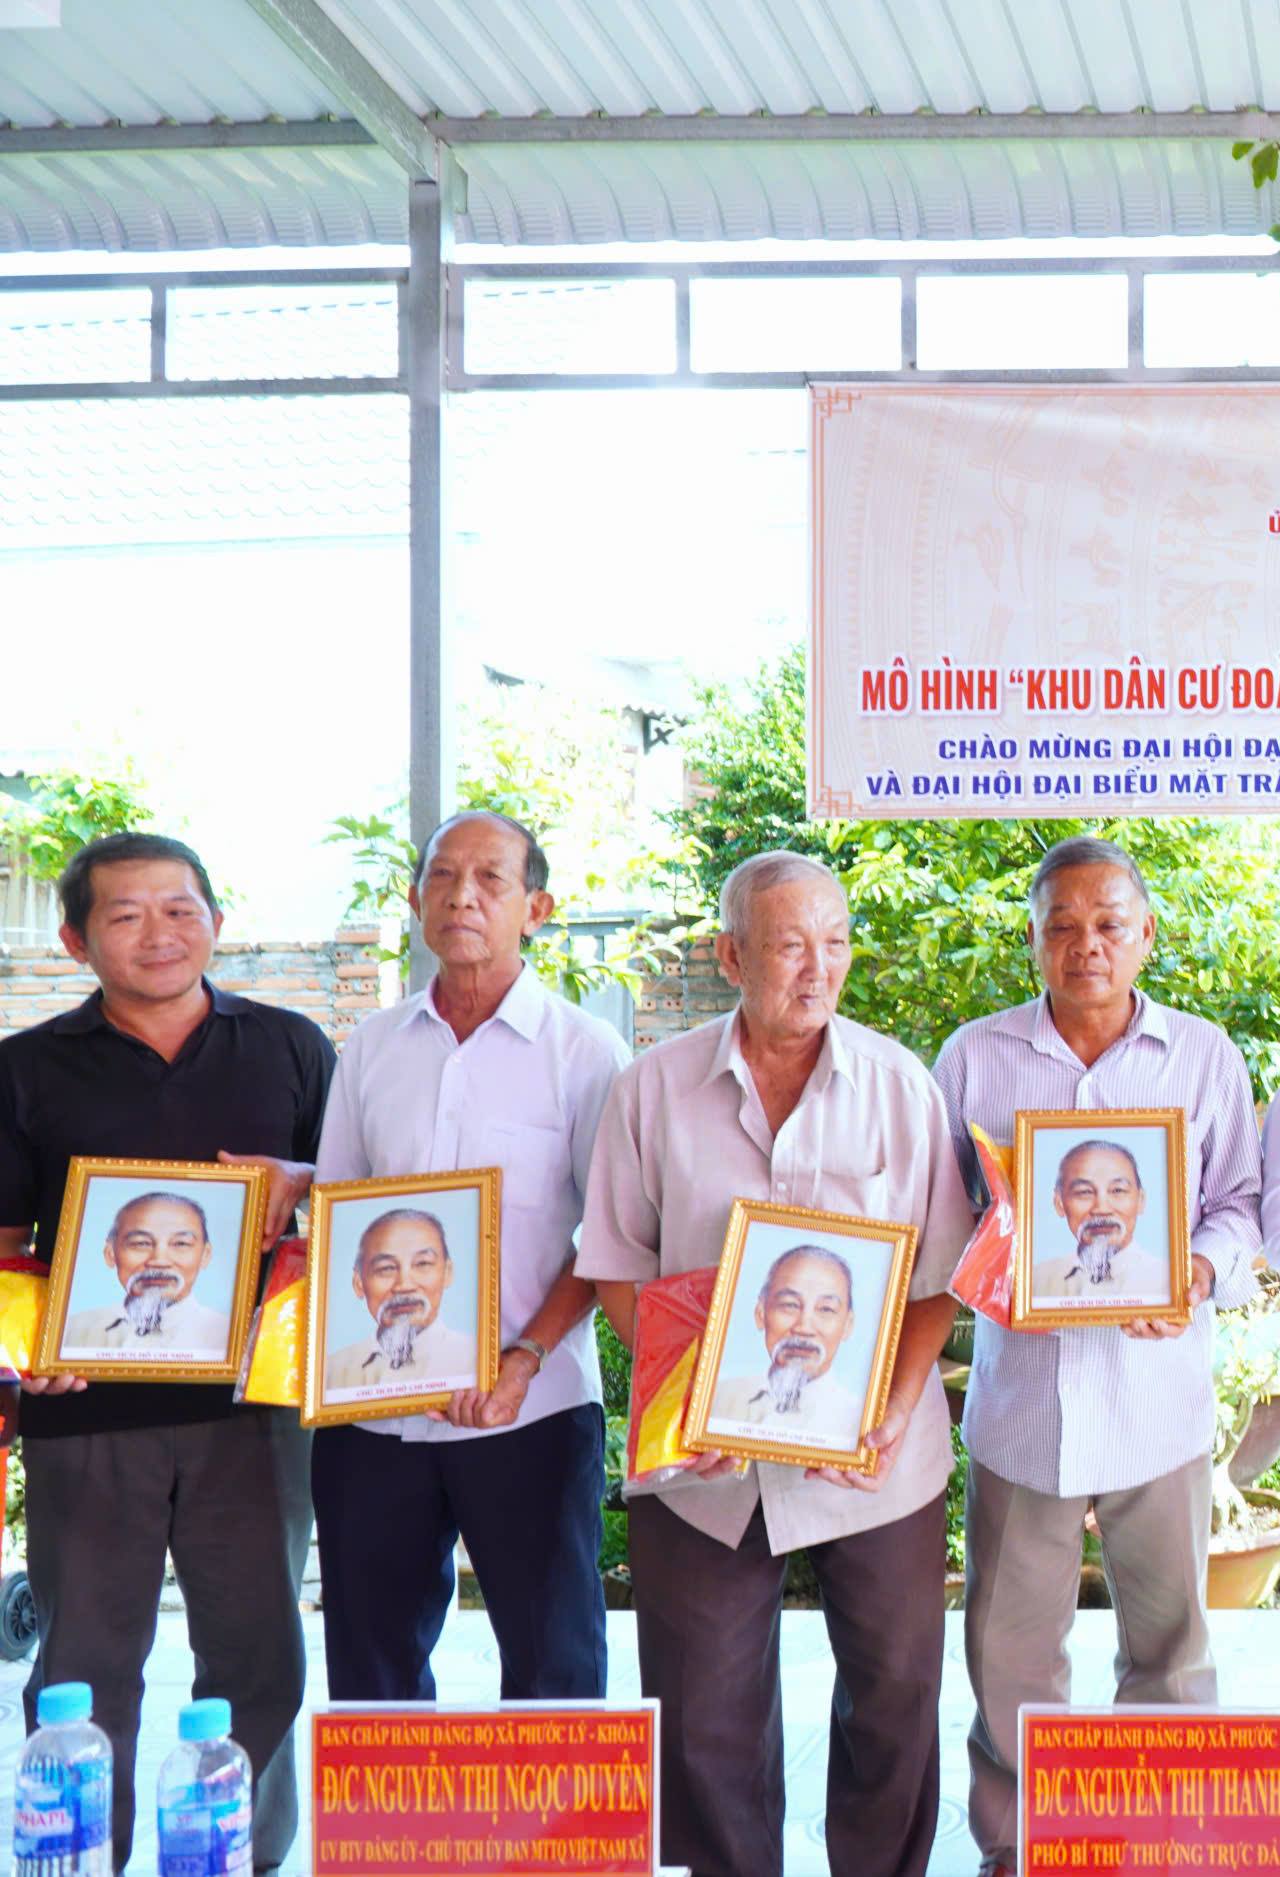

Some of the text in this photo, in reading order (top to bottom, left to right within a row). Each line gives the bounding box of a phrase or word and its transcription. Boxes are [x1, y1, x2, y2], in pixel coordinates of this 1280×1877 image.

[862, 656, 908, 711] MÔ
[921, 656, 997, 711] HÌNH
[1104, 655, 1166, 710] DÂN
[1178, 663, 1222, 710] CƯ
[938, 732, 1017, 760] CHÀO
[1028, 732, 1112, 759] MỪNG
[1123, 738, 1171, 763] ĐẠI
[1183, 733, 1232, 762] HỘI
[866, 769, 901, 795] VÀ
[912, 775, 960, 799] ĐẠI
[972, 769, 1021, 799] HỘI
[1033, 775, 1081, 799] ĐẠI
[1093, 765, 1158, 794] BIỂU
[1170, 768, 1227, 798] MẶT
[322, 1726, 349, 1746] BAN
[391, 1720, 430, 1746] HÀNH
[433, 1720, 472, 1746] ĐẢNG
[474, 1722, 494, 1749] BỘ
[496, 1720, 515, 1745] XÃ
[518, 1720, 566, 1745] PHƯỚC
[568, 1720, 587, 1745] LÝ
[1034, 1727, 1061, 1748] BAN
[1103, 1723, 1142, 1748] HÀNH
[1145, 1723, 1183, 1748] ĐẢNG
[1186, 1725, 1206, 1752] BỘ
[1208, 1723, 1226, 1748] XÃ
[1230, 1723, 1278, 1748] PHƯỚC
[322, 1765, 360, 1814] Đ/C
[364, 1750, 456, 1814] NGUYỄN
[460, 1764, 499, 1825] THỊ
[505, 1763, 568, 1825] NGỌC
[1034, 1767, 1071, 1817] Đ/C
[1074, 1753, 1163, 1817] NGUYỄN
[1167, 1767, 1206, 1831] THỊ
[321, 1839, 337, 1862] UV
[339, 1839, 362, 1862] BTV
[365, 1835, 399, 1863] ĐẢNG
[401, 1835, 419, 1863] ỦY
[426, 1834, 451, 1863] CHỦ
[455, 1839, 484, 1867] TỊCH
[486, 1834, 503, 1862] ỦY
[505, 1839, 530, 1862] BAN
[569, 1835, 597, 1867] VIỆT
[599, 1838, 627, 1861] NAM
[629, 1834, 646, 1860] XÃ
[1033, 1837, 1068, 1866] PHÓ
[1071, 1837, 1089, 1866] BÍ
[1091, 1840, 1129, 1867] THƯ
[1131, 1836, 1203, 1867] THƯỜNG
[1207, 1840, 1253, 1871] TRỰC
